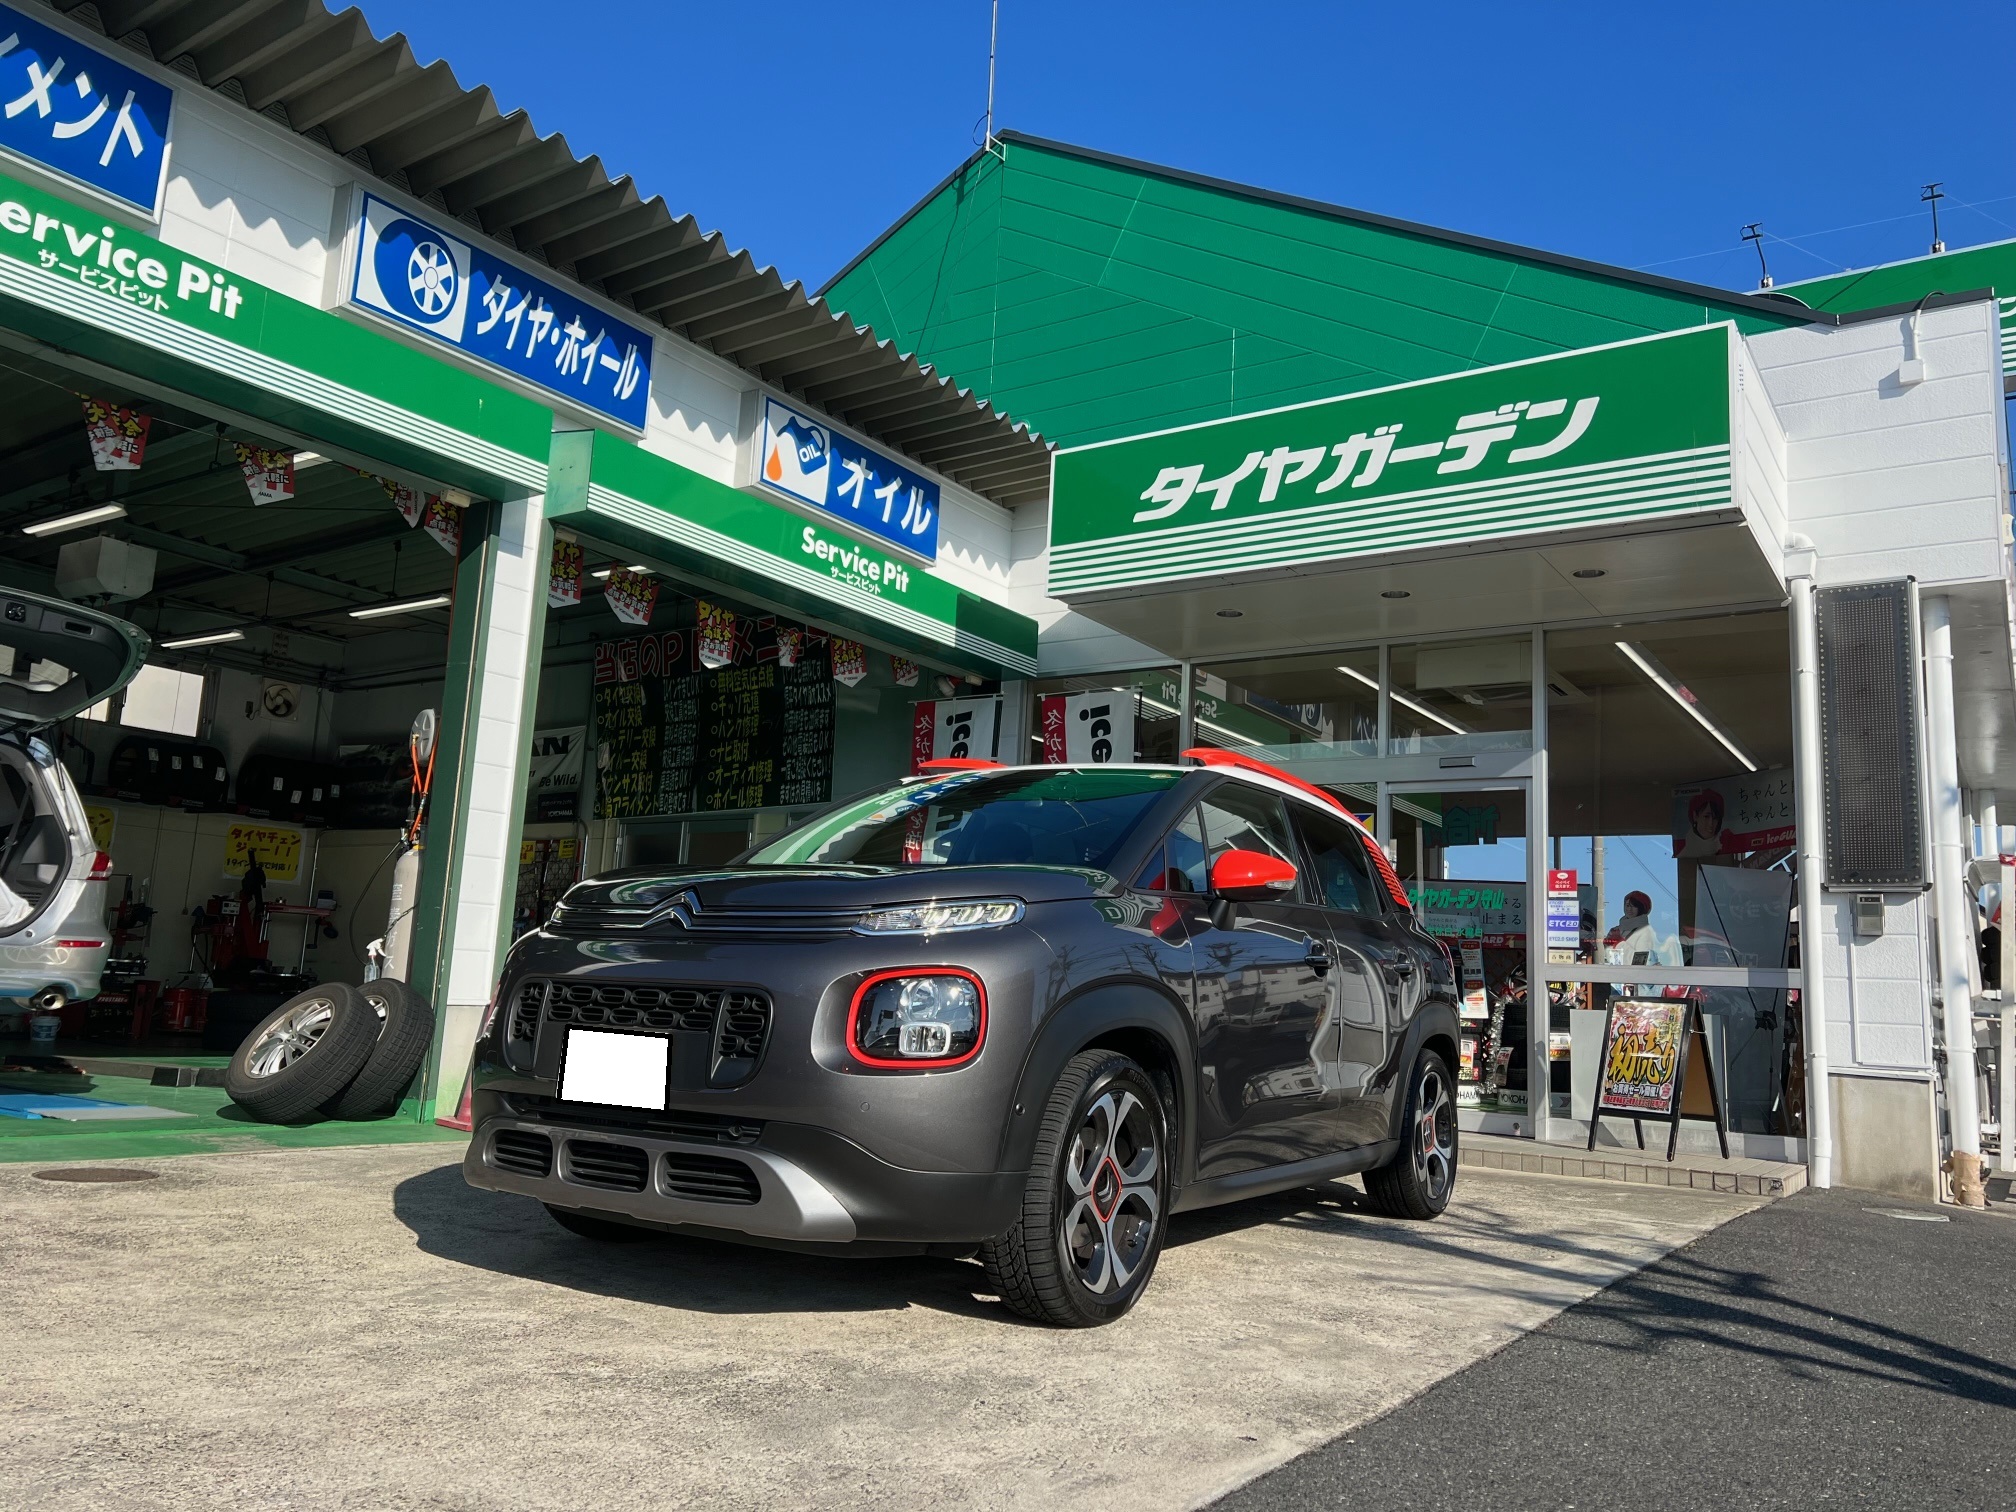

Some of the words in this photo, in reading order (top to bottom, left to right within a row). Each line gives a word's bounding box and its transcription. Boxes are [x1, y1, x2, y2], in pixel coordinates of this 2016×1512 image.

[0, 33, 143, 167] メント
[38, 249, 169, 312] サービスピット
[177, 260, 242, 319] Pit
[477, 274, 640, 400] タイヤ・ホイール
[800, 443, 821, 463] OIL
[1133, 397, 1600, 522] タイヤガーデン
[837, 458, 931, 534] オイル
[801, 526, 880, 581] Service
[883, 561, 909, 592] Pit
[831, 565, 881, 595] サービスピット
[718, 664, 774, 693] 無料空気圧点検
[605, 705, 642, 728] オイル交換
[718, 690, 759, 716] チッソ充填
[602, 726, 656, 750] ッテリー交換
[608, 750, 647, 772] イパー交換
[715, 759, 773, 786] オーディオ修理
[714, 784, 763, 809] ホイール修理
[1740, 801, 1796, 825] ちゃんと
[231, 827, 300, 846] タイヤチェン
[1408, 888, 1505, 909] タイヤガーデン守山
[1607, 1023, 1675, 1085] 初売り
